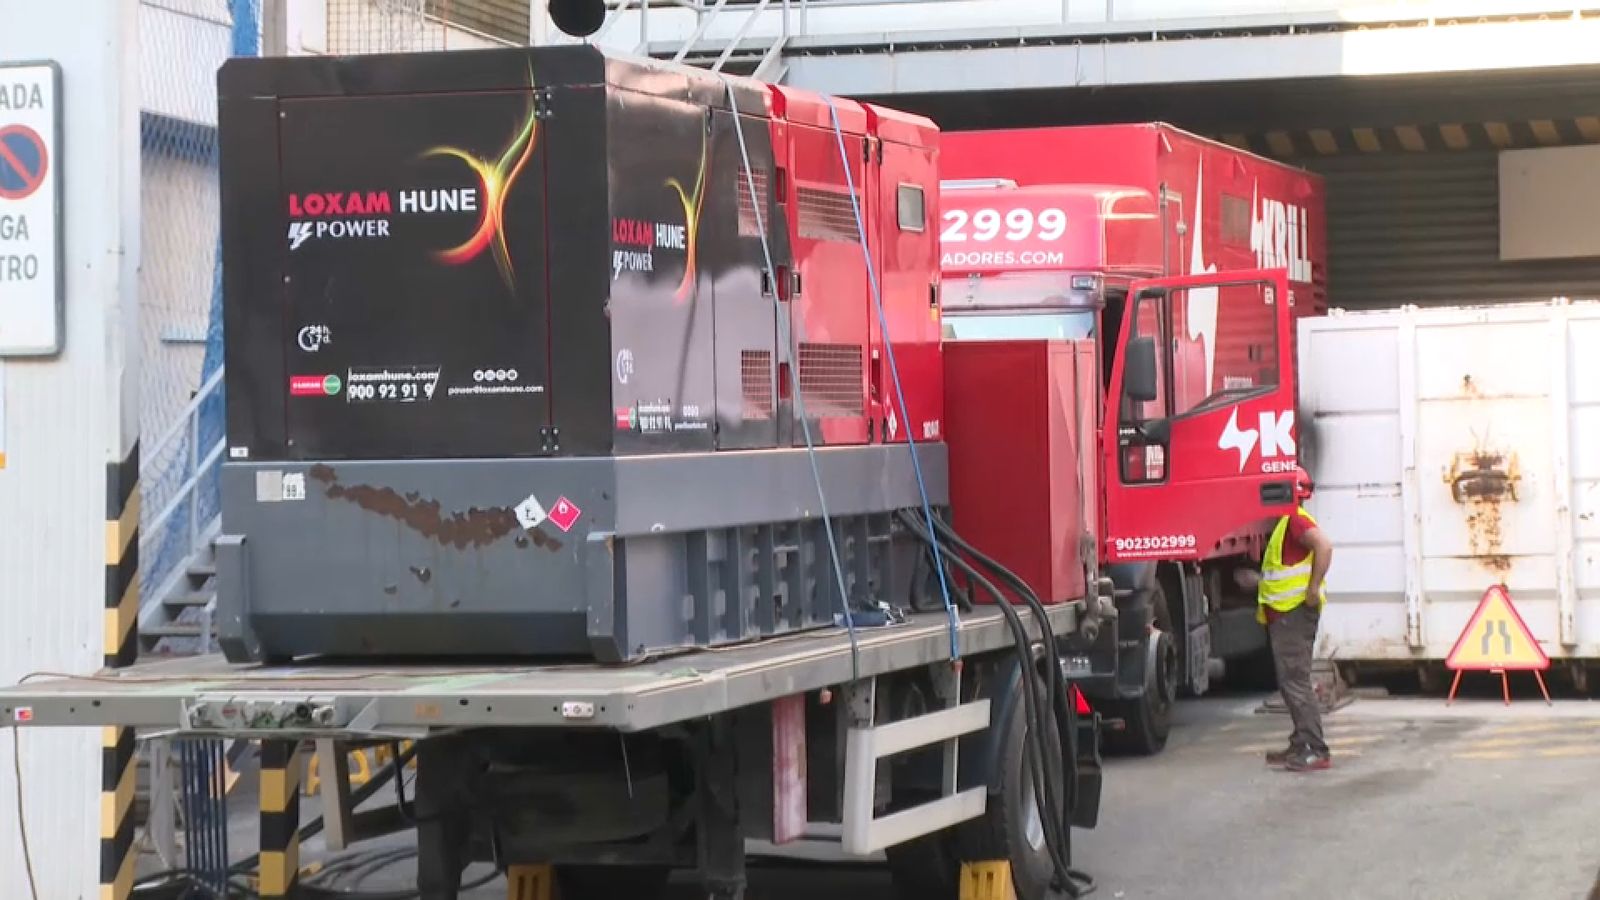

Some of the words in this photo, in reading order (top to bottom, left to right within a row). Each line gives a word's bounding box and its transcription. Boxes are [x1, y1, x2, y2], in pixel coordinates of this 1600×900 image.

[288, 191, 392, 217] LOXAM
[399, 187, 477, 212] HUNE
[316, 219, 390, 238] POWER
[612, 216, 654, 246] LOXAM
[656, 222, 686, 249] HUNE
[940, 208, 1068, 242] 2999
[1262, 197, 1312, 284] KRILL
[624, 250, 653, 271] POWER
[941, 251, 1064, 266] ADORES.COM
[348, 369, 439, 381] loxamhune.com
[349, 384, 374, 400] 900
[379, 383, 397, 399] 92
[401, 382, 417, 398] 91
[1259, 410, 1296, 457] K
[1116, 534, 1196, 551] 902302999
